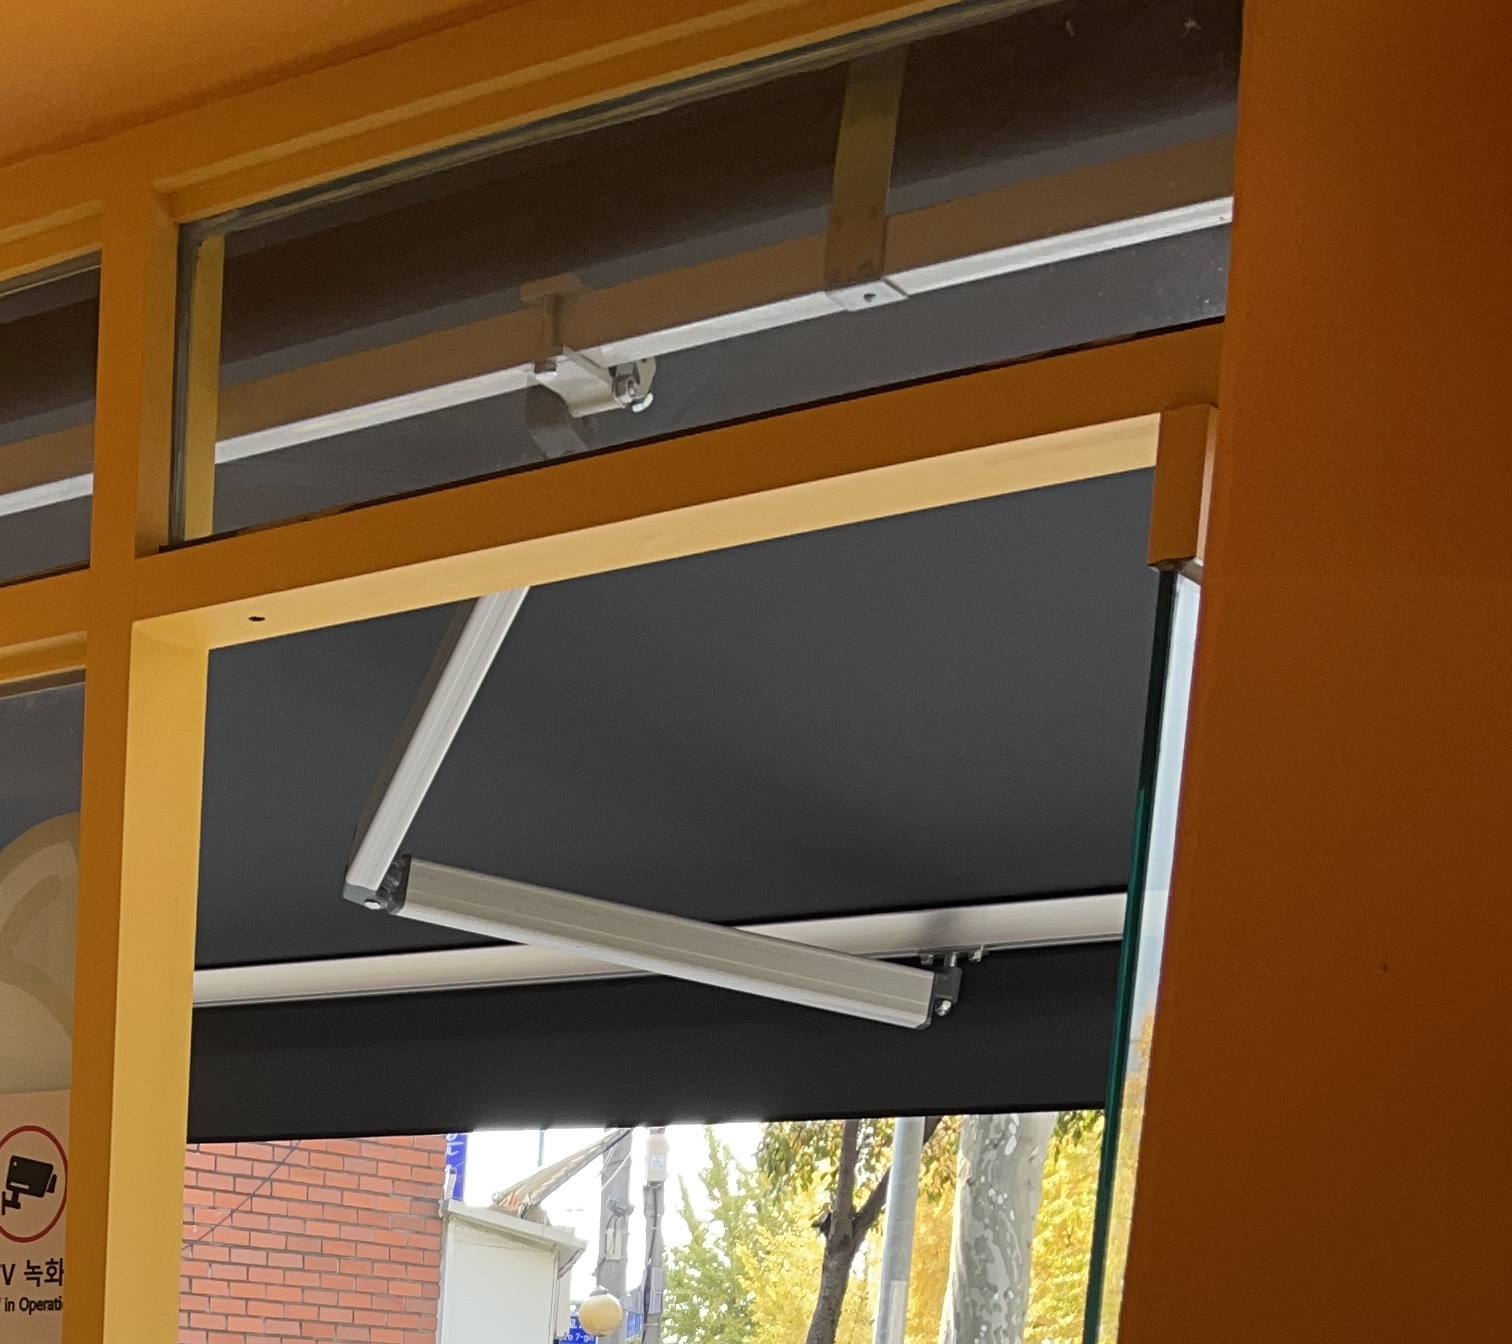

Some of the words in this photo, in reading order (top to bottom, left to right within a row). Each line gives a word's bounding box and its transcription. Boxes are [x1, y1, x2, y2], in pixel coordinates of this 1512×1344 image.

[23, 1258, 65, 1287] 녹화
[4, 1297, 15, 1312] in
[19, 1295, 64, 1315] Operati
